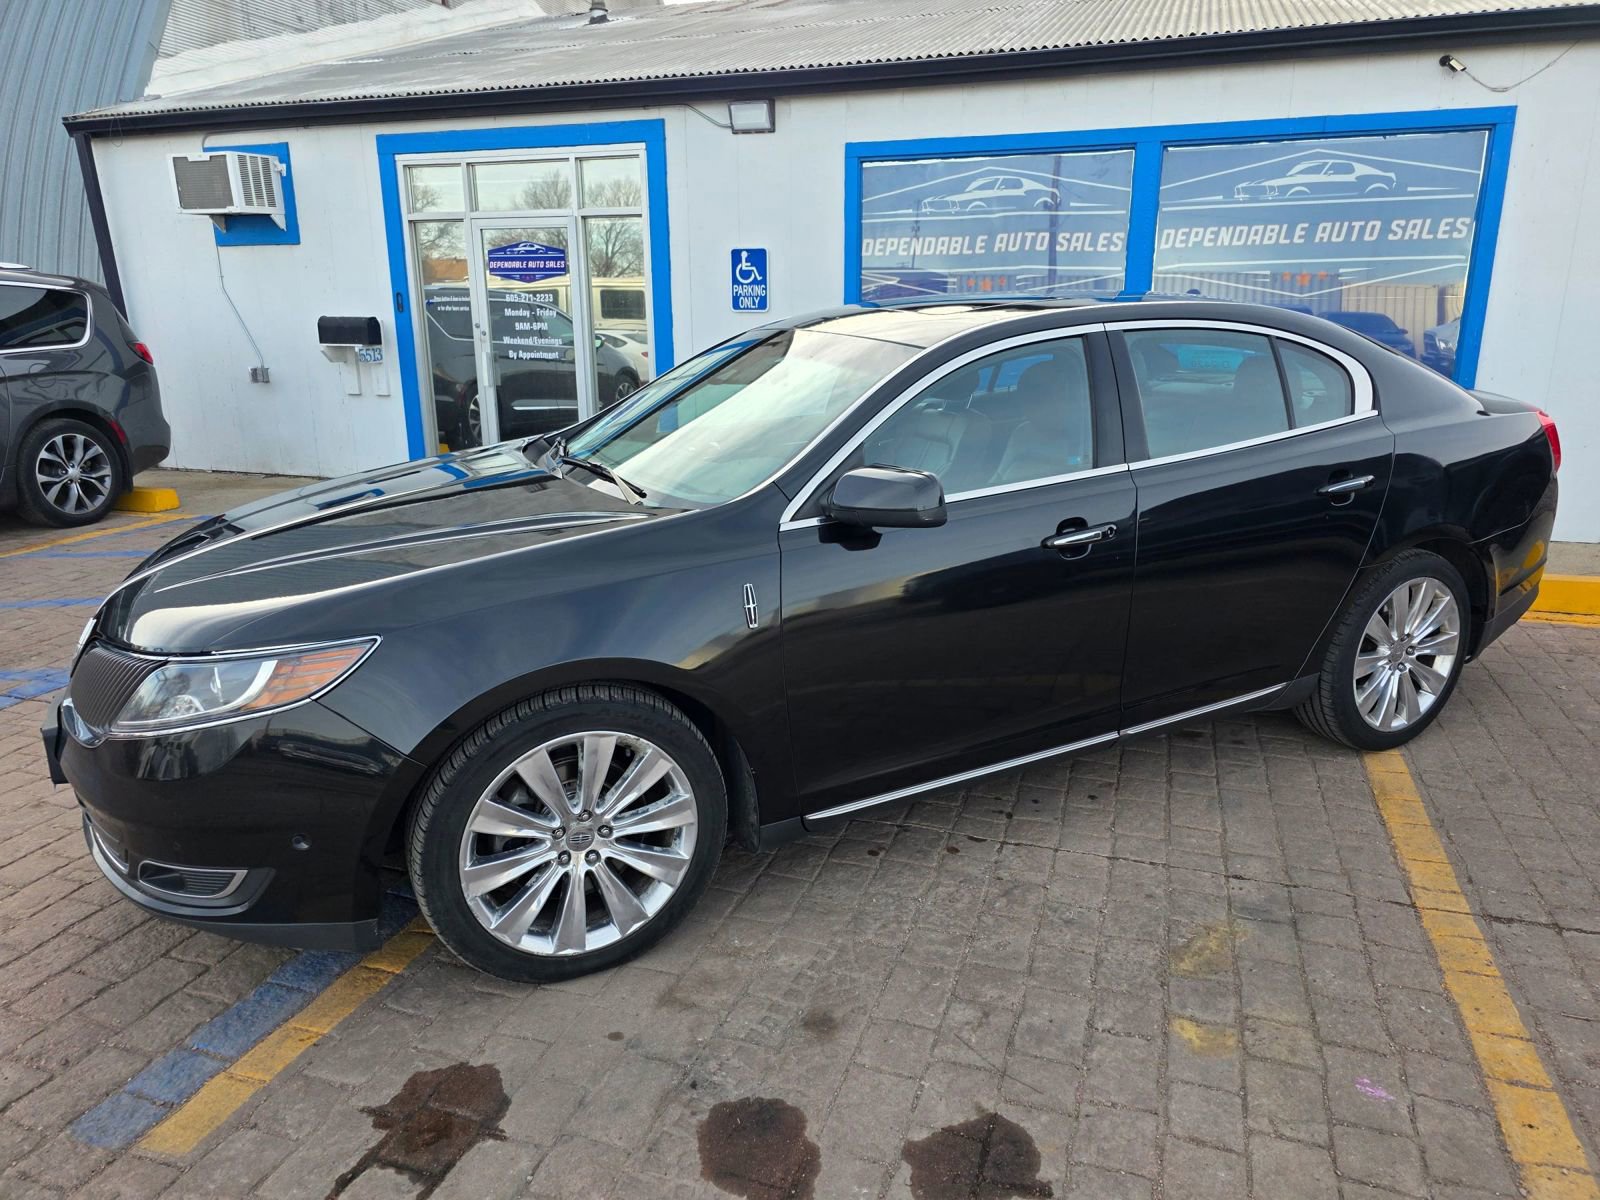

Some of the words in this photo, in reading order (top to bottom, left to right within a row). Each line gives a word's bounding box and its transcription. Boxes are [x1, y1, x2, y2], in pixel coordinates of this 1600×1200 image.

[1160, 223, 1309, 249] DEPENDABLE
[1314, 220, 1382, 243] AUTO
[1387, 216, 1472, 241] SALES
[861, 235, 988, 256] DEPENDABLE
[993, 231, 1049, 253] AUTO
[1056, 231, 1125, 253] SALES
[733, 284, 766, 297] PARKING
[739, 296, 760, 309] ONLY
[504, 308, 530, 318] Monday
[536, 308, 557, 318] Friday
[515, 322, 548, 330] 9AM-6PM
[503, 336, 563, 345] Weekend/Evenings
[358, 347, 383, 362] 5513
[508, 350, 518, 360] By
[518, 350, 559, 360] Appointment
